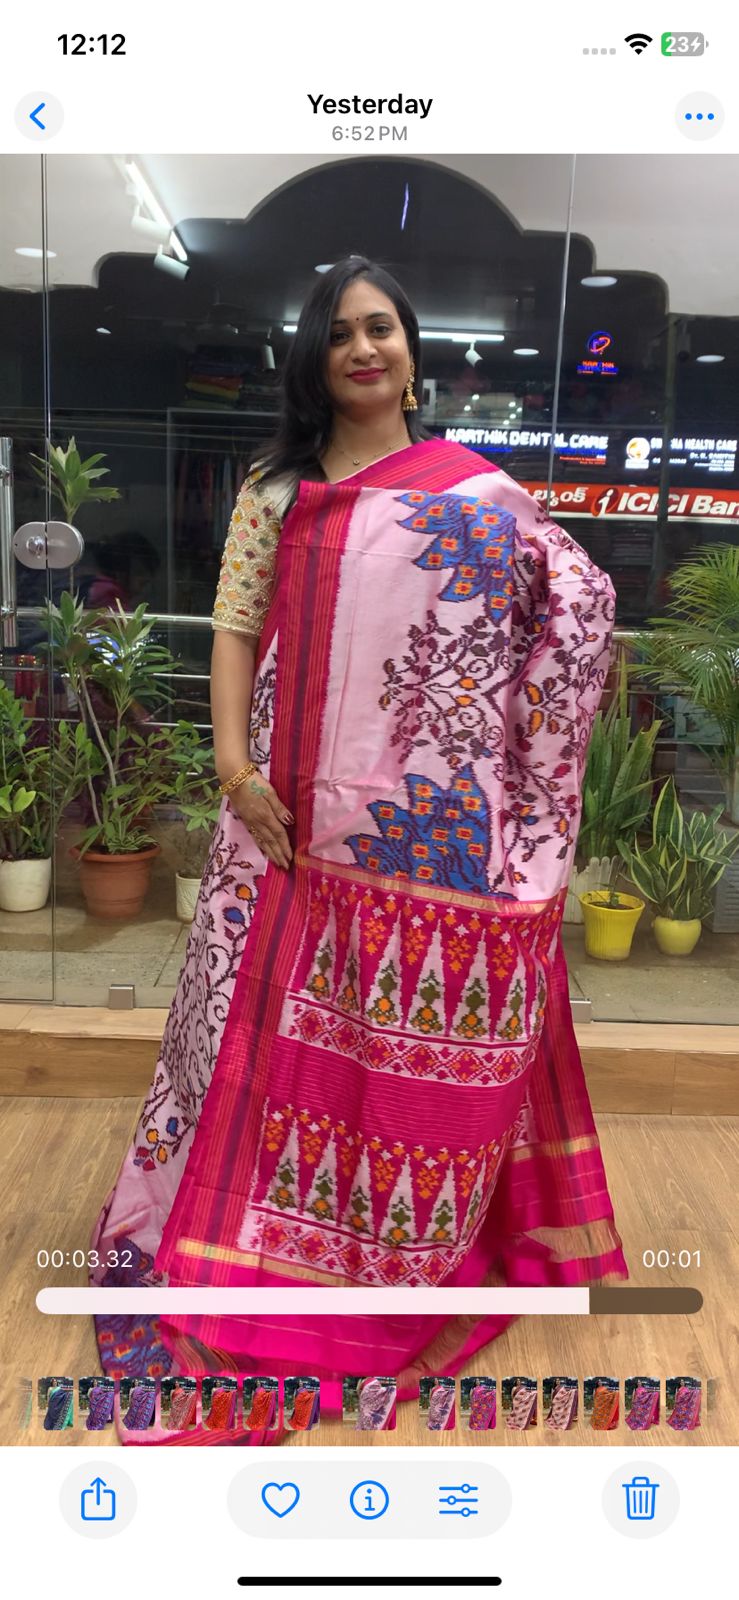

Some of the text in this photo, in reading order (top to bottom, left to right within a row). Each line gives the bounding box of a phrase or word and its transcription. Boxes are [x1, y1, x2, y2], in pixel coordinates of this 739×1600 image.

[445, 428, 508, 445] KARTHIK
[569, 434, 608, 449] CARE
[685, 438, 715, 451] HEALTH
[716, 439, 738, 452] CARE
